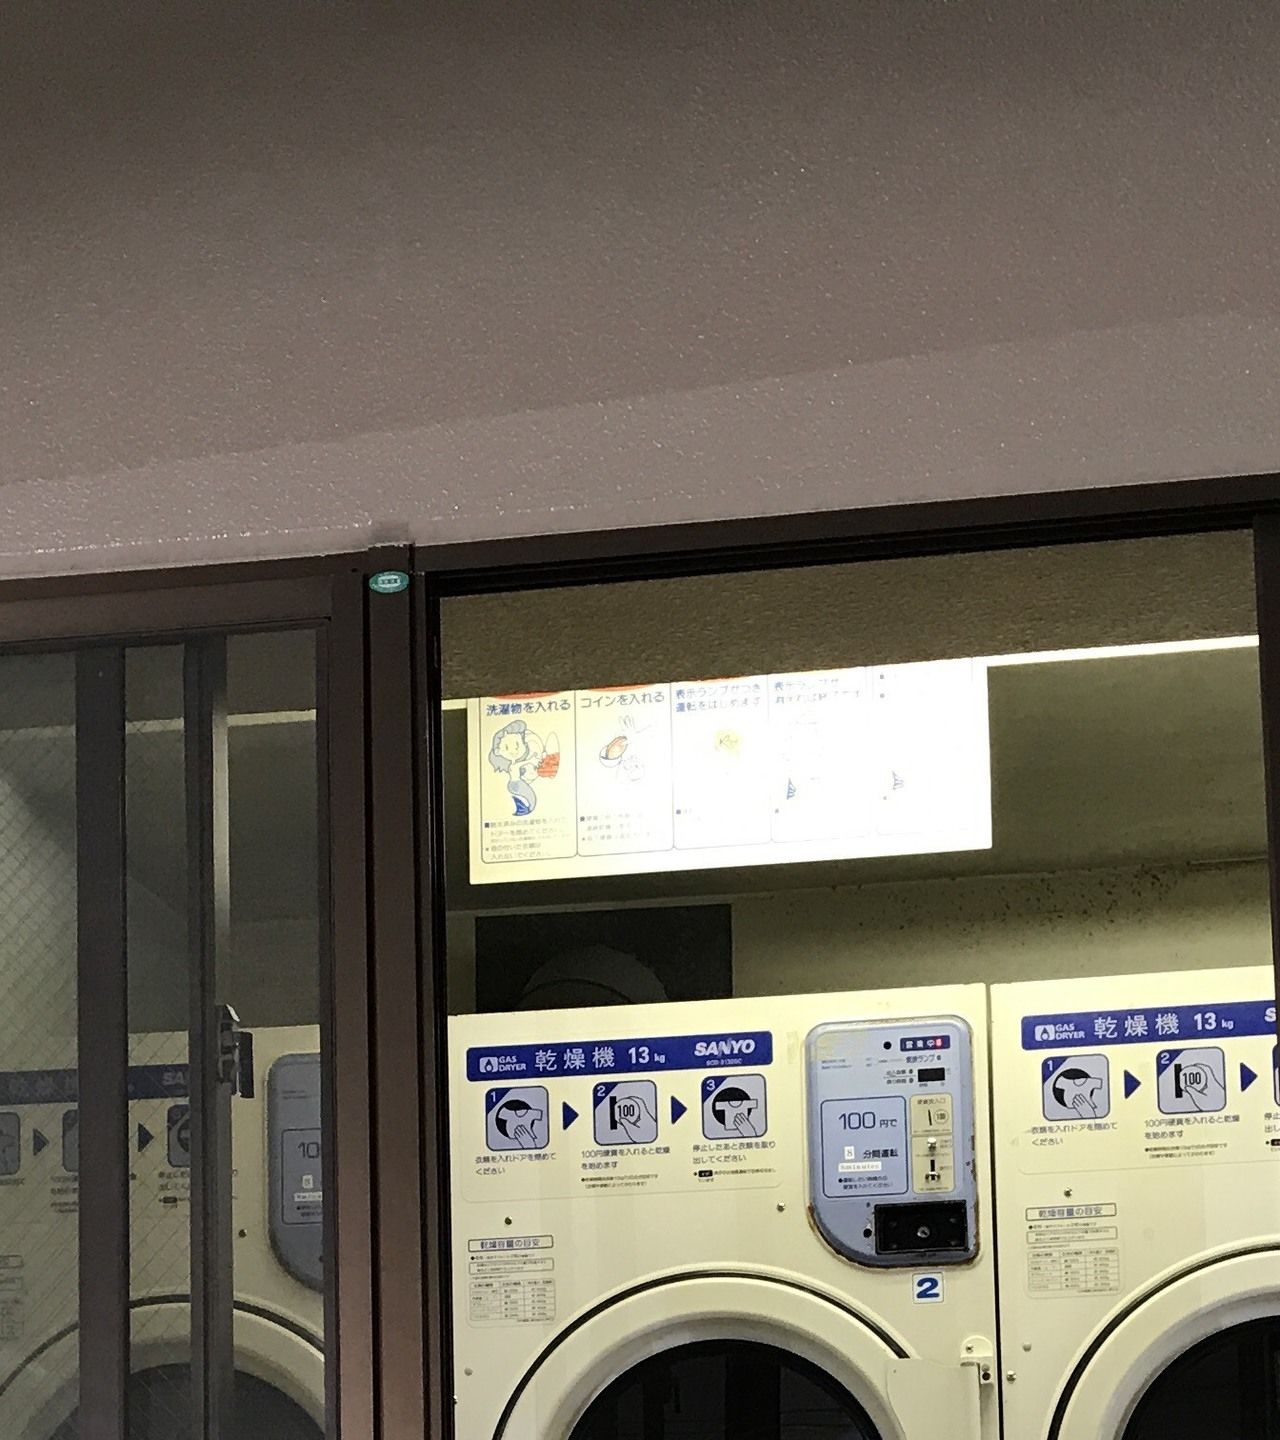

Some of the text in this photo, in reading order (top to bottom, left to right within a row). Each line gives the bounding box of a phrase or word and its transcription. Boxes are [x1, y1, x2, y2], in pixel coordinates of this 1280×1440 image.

[581, 692, 665, 709] コインを入れる
[486, 701, 571, 717] 洗濯物を入れる
[1056, 1023, 1075, 1031] GAS
[1093, 1012, 1234, 1039] 乾燥機 13 kg
[1056, 1031, 1085, 1040] DRYER
[694, 1039, 755, 1056] SANYO
[499, 1055, 517, 1063] GAS
[535, 1047, 666, 1072] 乾燥機 13 kg
[1161, 1054, 1170, 1065] 2
[499, 1063, 527, 1072] DRYER
[1183, 1072, 1202, 1086] 100
[597, 1086, 606, 1097] 2
[706, 1080, 716, 1091] 3
[618, 1104, 635, 1117] 100
[839, 1111, 898, 1130] 100 円で
[1032, 1136, 1064, 1146] ください
[475, 1166, 506, 1176] ください
[917, 1277, 940, 1298] 2
